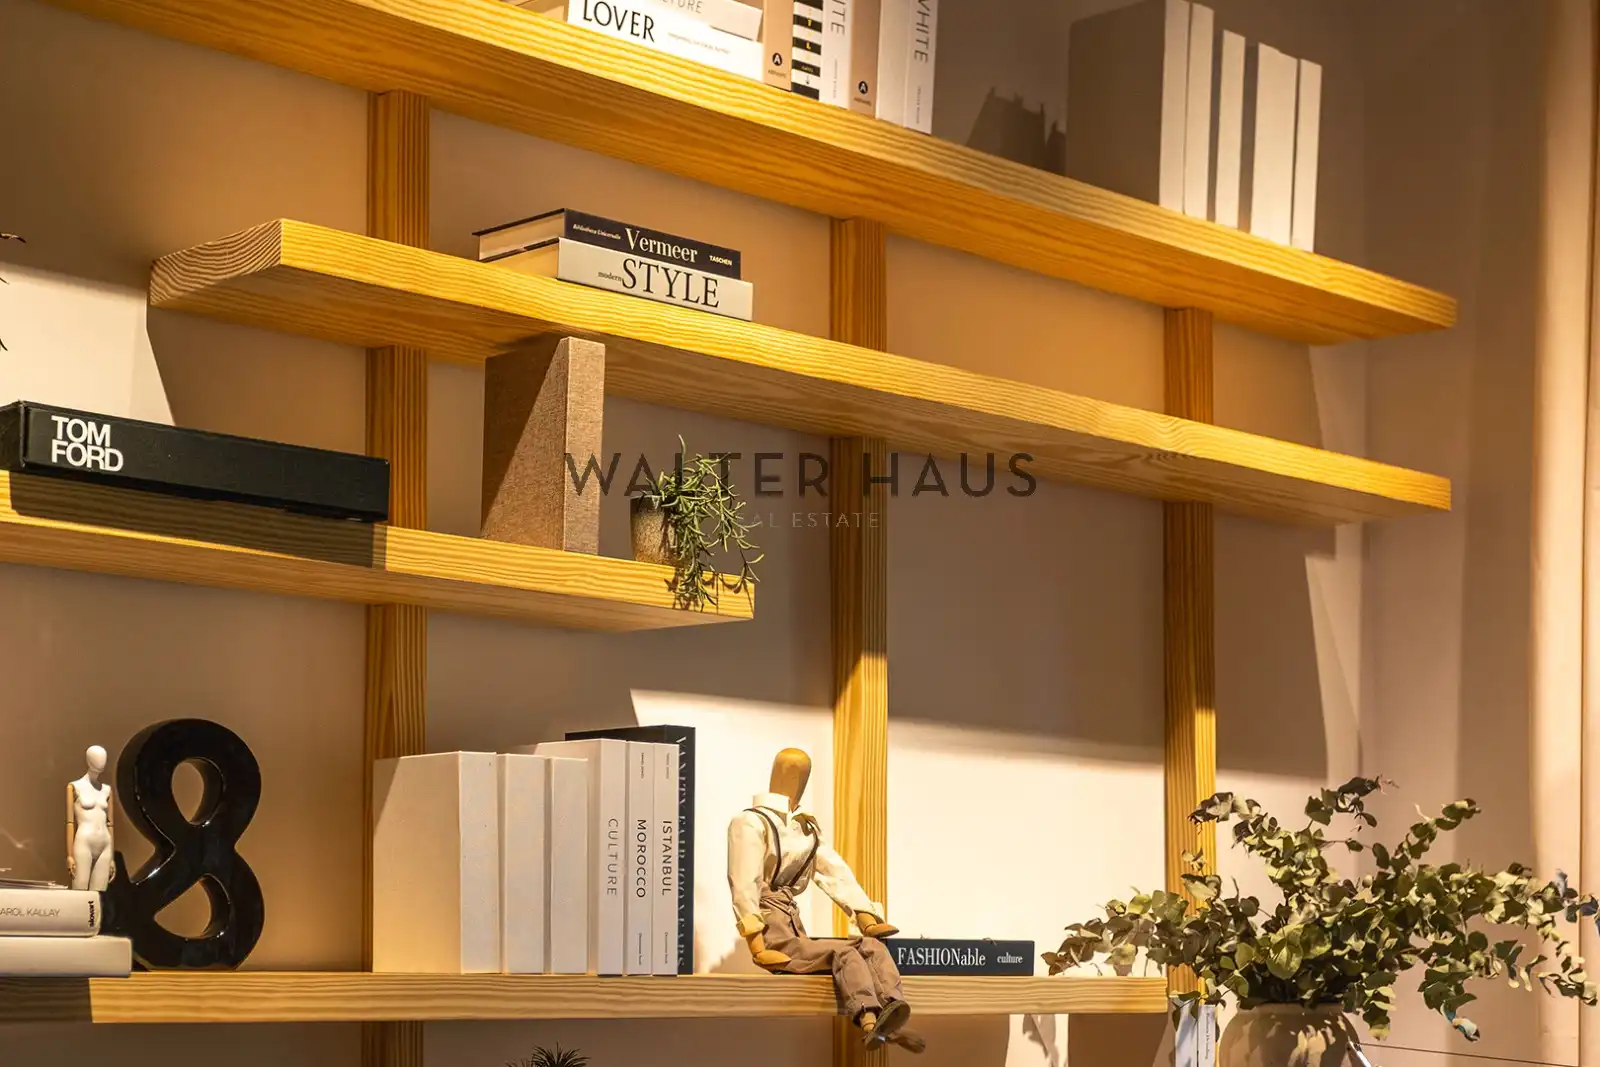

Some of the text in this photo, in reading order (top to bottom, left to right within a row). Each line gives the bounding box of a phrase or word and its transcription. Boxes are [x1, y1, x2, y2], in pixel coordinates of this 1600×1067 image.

[583, 0, 655, 42] LOVER
[624, 227, 698, 263] Vermeer
[709, 255, 733, 266] TASCHEN
[598, 258, 720, 308] modern STYLE
[51, 415, 111, 447] TOM
[51, 439, 124, 472] FORD
[607, 818, 619, 896] CULTURE
[636, 819, 647, 898] MOROCCO
[662, 820, 673, 896] ISTANBUL
[897, 947, 1023, 966] FASHIONable culture
